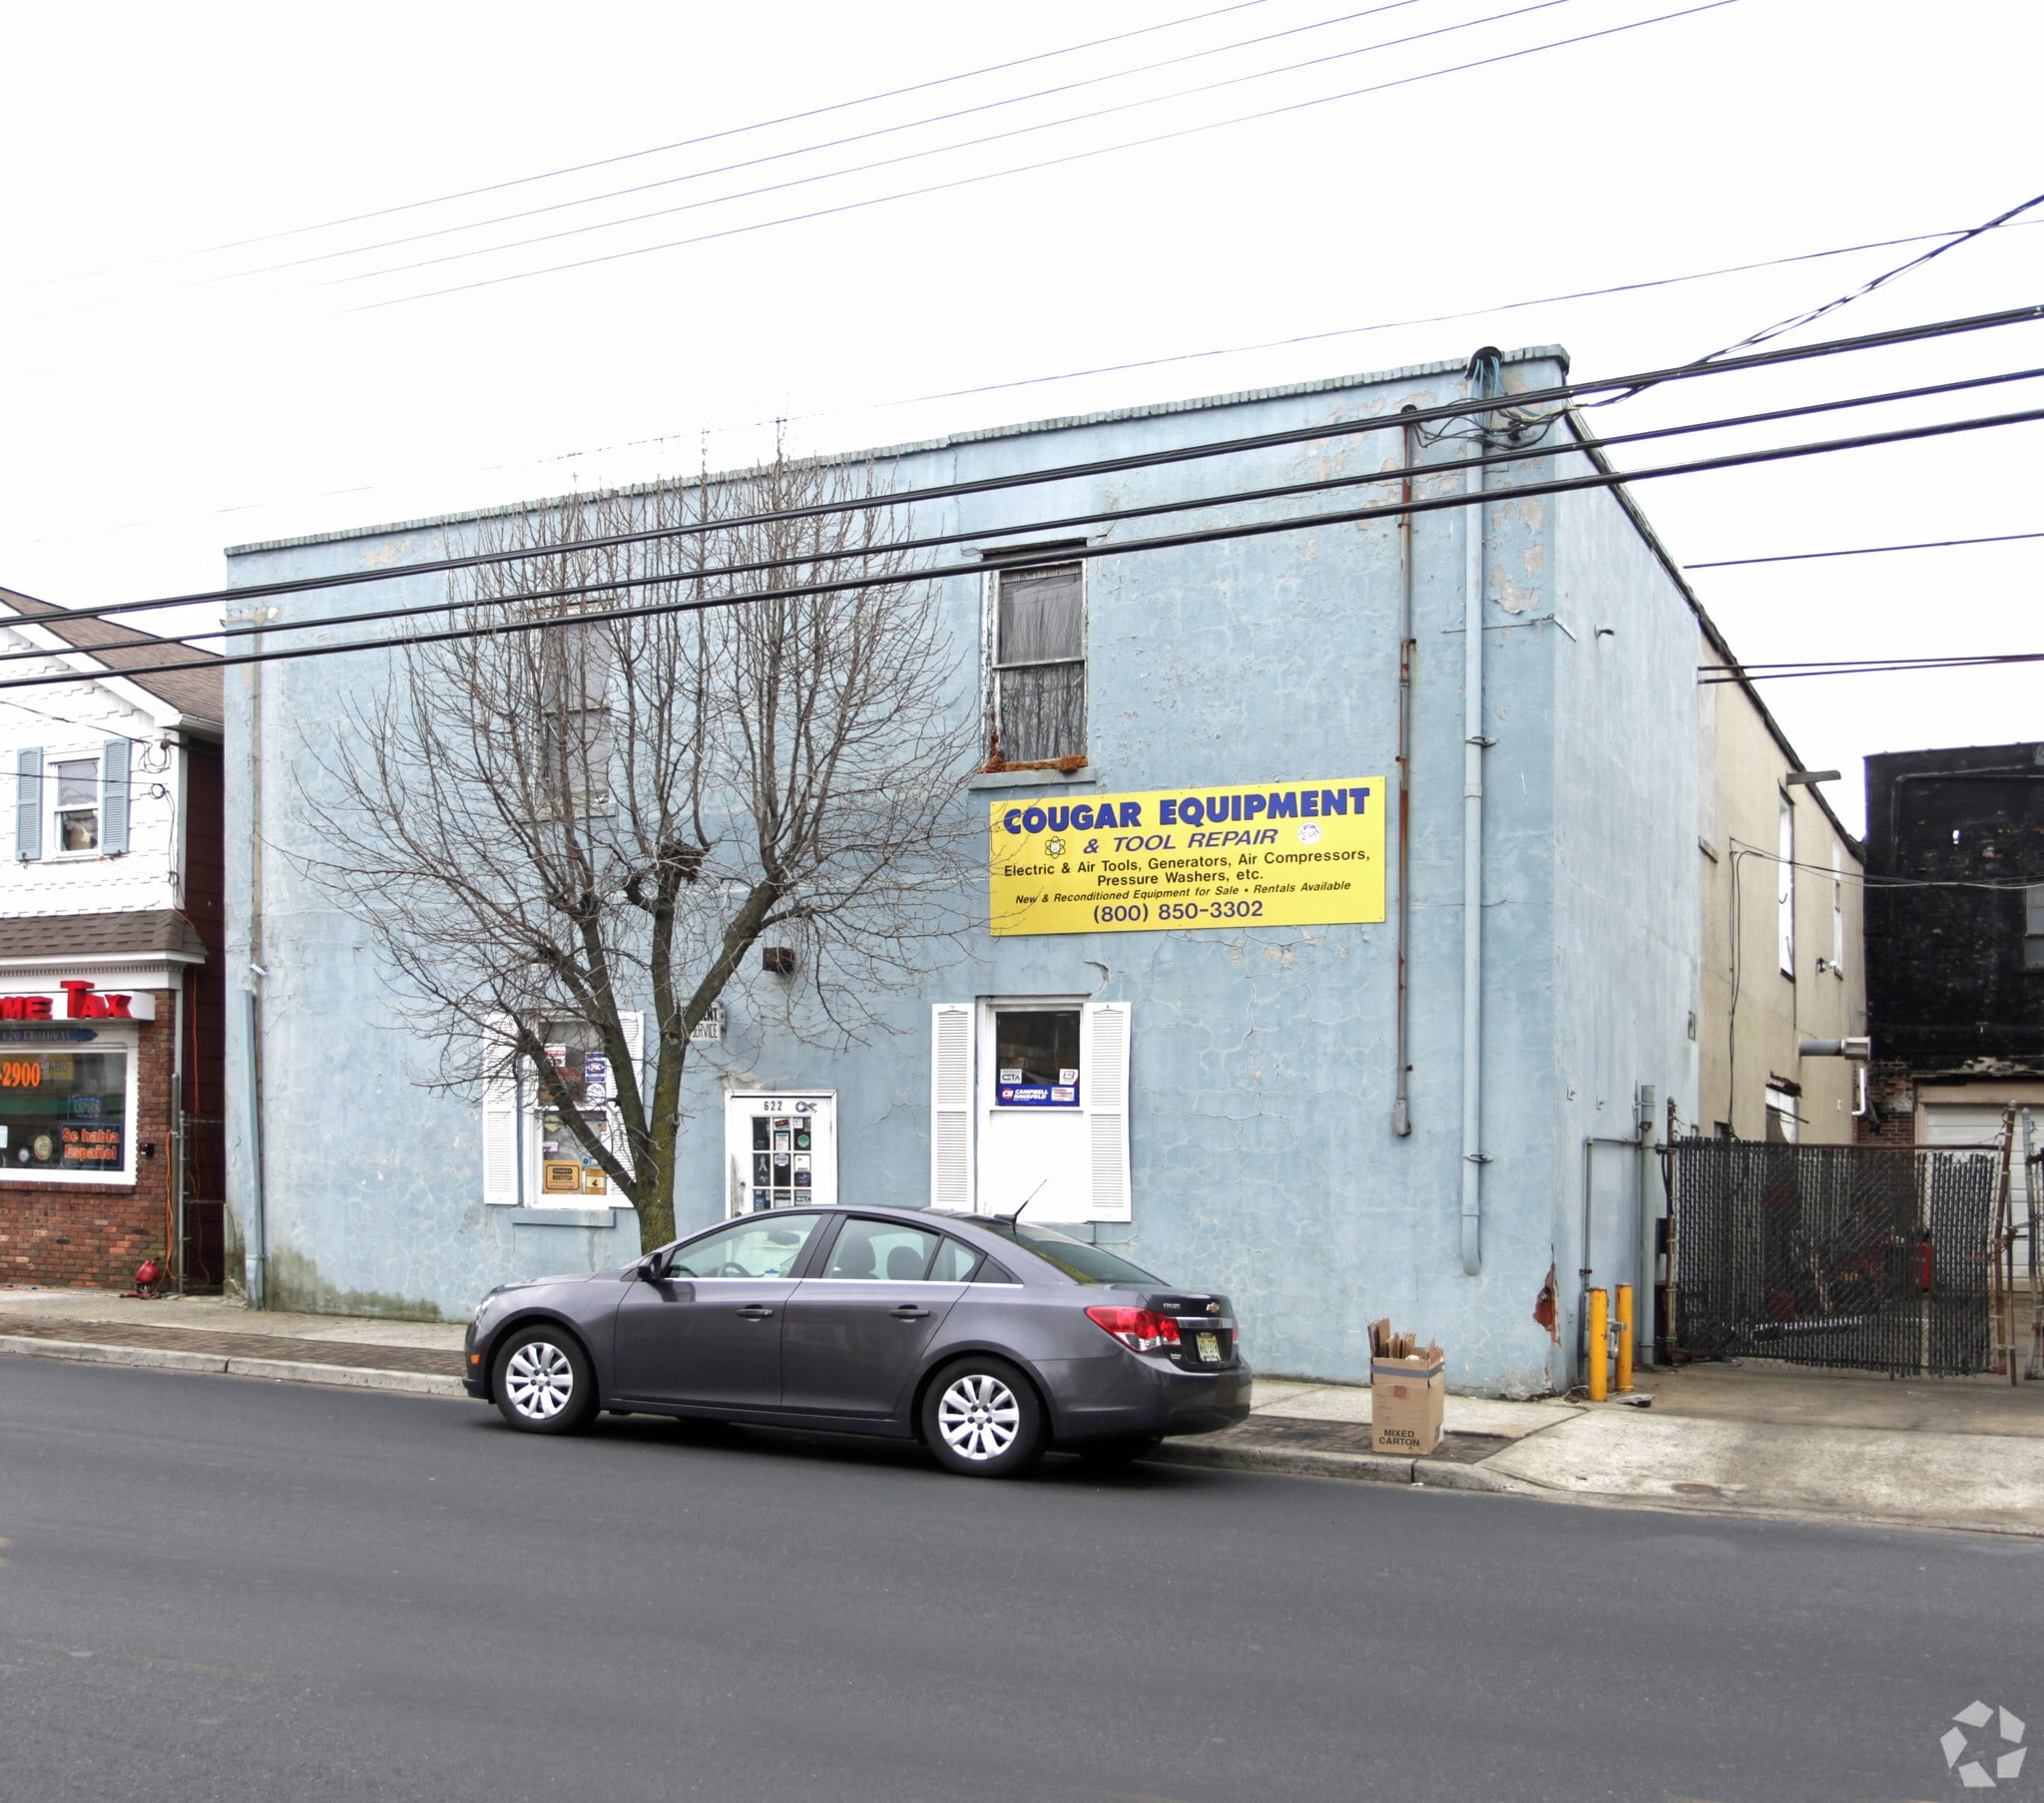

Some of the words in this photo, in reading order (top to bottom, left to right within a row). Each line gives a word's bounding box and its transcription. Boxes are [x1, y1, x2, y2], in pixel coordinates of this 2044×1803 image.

[1003, 801, 1142, 835] COUGAR
[1160, 787, 1370, 828] EQUIPMENT
[1083, 838, 1099, 854] &
[1114, 834, 1176, 852] TOOL
[1188, 828, 1278, 849] REPAIR
[1004, 863, 1055, 877] Electric
[1061, 862, 1071, 874] &
[1077, 861, 1096, 873] Air
[1101, 859, 1142, 872] Tools,
[1148, 855, 1232, 870] Generators,
[1238, 853, 1258, 865] Air
[1264, 849, 1370, 865] Compressors,
[1097, 874, 1159, 887] Pressure
[1165, 870, 1230, 884] Washers,
[1236, 868, 1265, 880] etc.
[1015, 894, 1038, 904] New
[1041, 894, 1049, 903] &
[1053, 890, 1131, 902] Reconditioned
[1133, 887, 1191, 899] Equipment
[1195, 887, 1211, 897] for
[1215, 885, 1240, 896] Sale
[1254, 883, 1295, 894] Rentals
[1299, 880, 1351, 892] Available
[1093, 903, 1149, 924] (800)
[1158, 900, 1264, 920] 850-3302
[764, 1101, 783, 1112] 622
[62, 1127, 79, 1142] Se
[64, 1143, 118, 1162] Español
[1378, 1436, 1420, 1447] CARTON
[1383, 1428, 1415, 1438] MIXED
